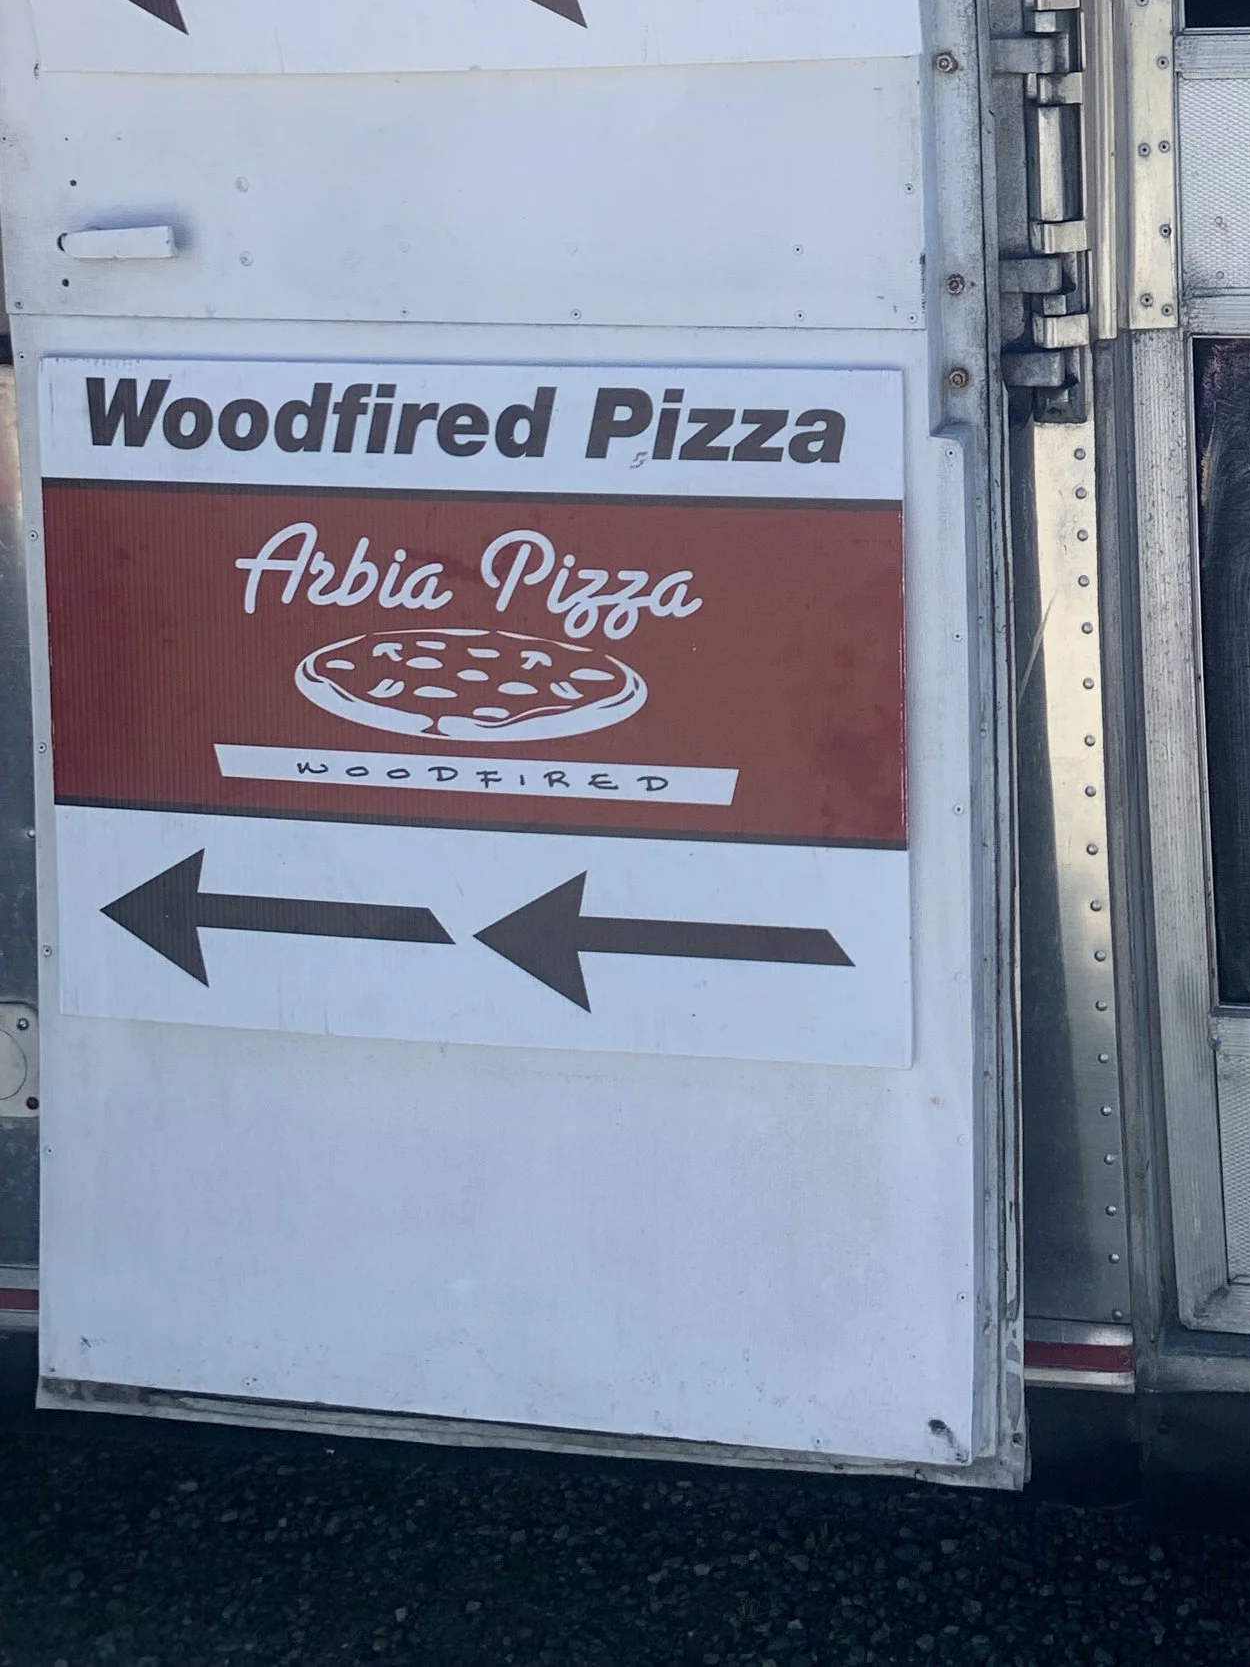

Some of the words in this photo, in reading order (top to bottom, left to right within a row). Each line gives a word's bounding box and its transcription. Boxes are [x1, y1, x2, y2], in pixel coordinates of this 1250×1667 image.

[86, 376, 557, 458] Woodfired
[585, 387, 847, 464] Pizza
[235, 522, 453, 615] Arbia
[480, 529, 703, 640] Pizza
[296, 761, 670, 792] WOODFIRED
